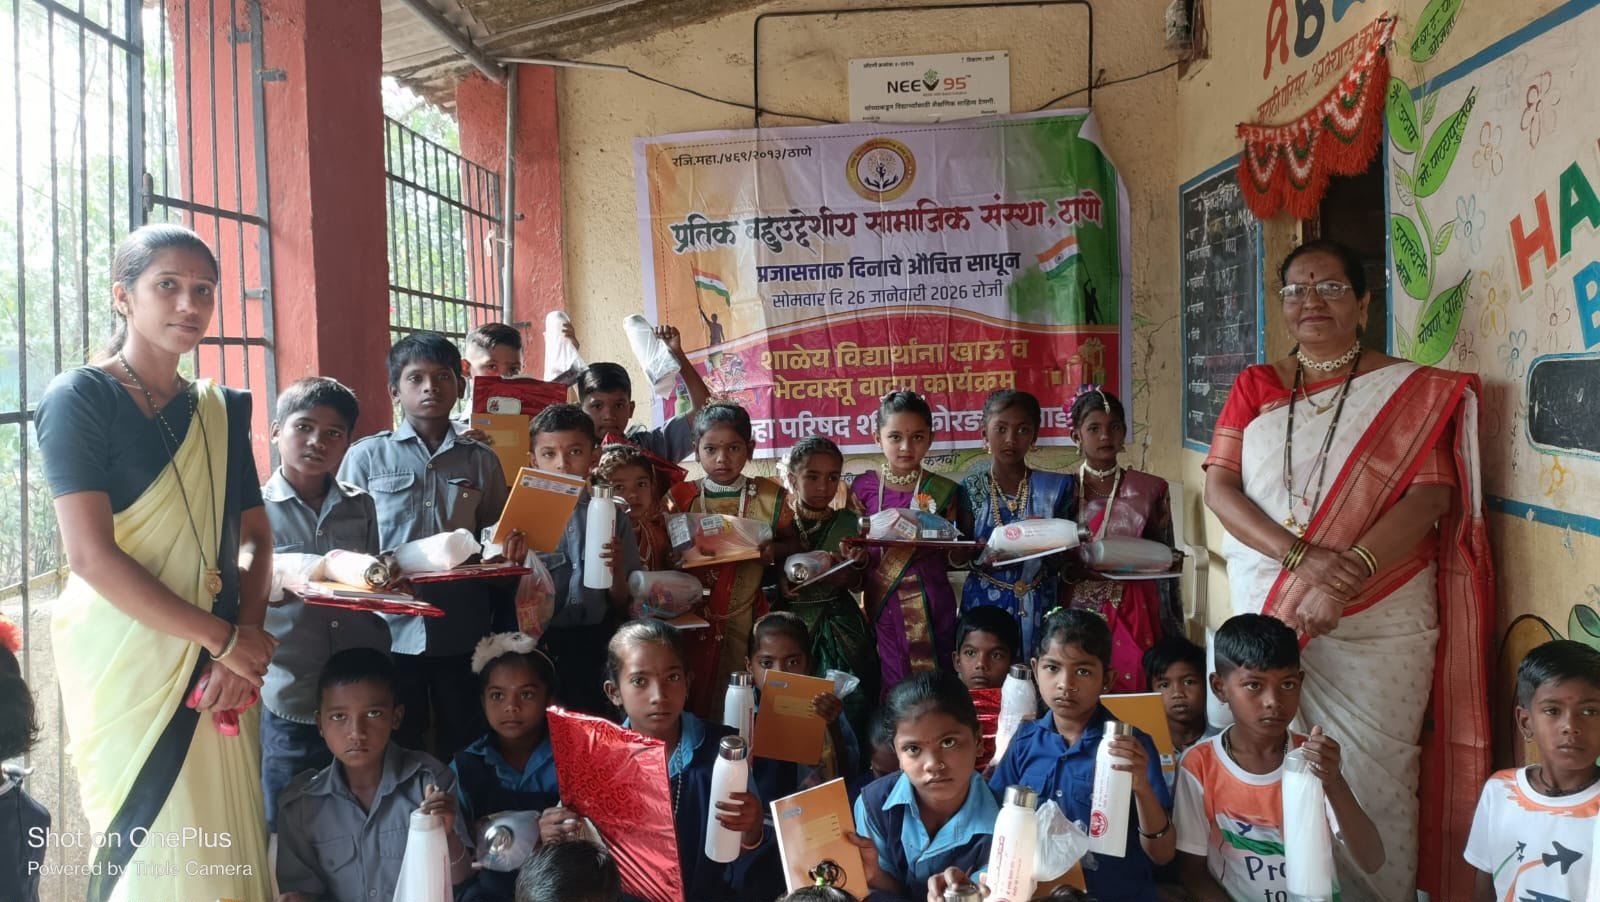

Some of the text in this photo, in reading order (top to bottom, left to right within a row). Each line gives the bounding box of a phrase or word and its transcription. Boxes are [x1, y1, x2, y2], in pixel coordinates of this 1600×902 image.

[887, 77, 967, 94] NEEV 95
[670, 213, 739, 253] प्रतिक
[863, 198, 974, 236] सामाजिक
[1057, 190, 1103, 225] ठाणे
[1509, 138, 1600, 292] HA
[757, 262, 845, 283] प्रजासत्ताक
[849, 255, 903, 279] दिनाचे
[966, 252, 1021, 276] साधून
[772, 280, 1004, 308] सोमवार दि 26 जानेवारी 2026 रोजी
[761, 343, 832, 371] शाळेय
[949, 341, 1006, 362] खाऊ
[1012, 339, 1029, 359] व
[773, 375, 856, 406] भेटवस्तू
[921, 366, 1018, 393] कार्यक्रम
[779, 410, 851, 438] परिषद
[1244, 855, 1287, 881] Pr
